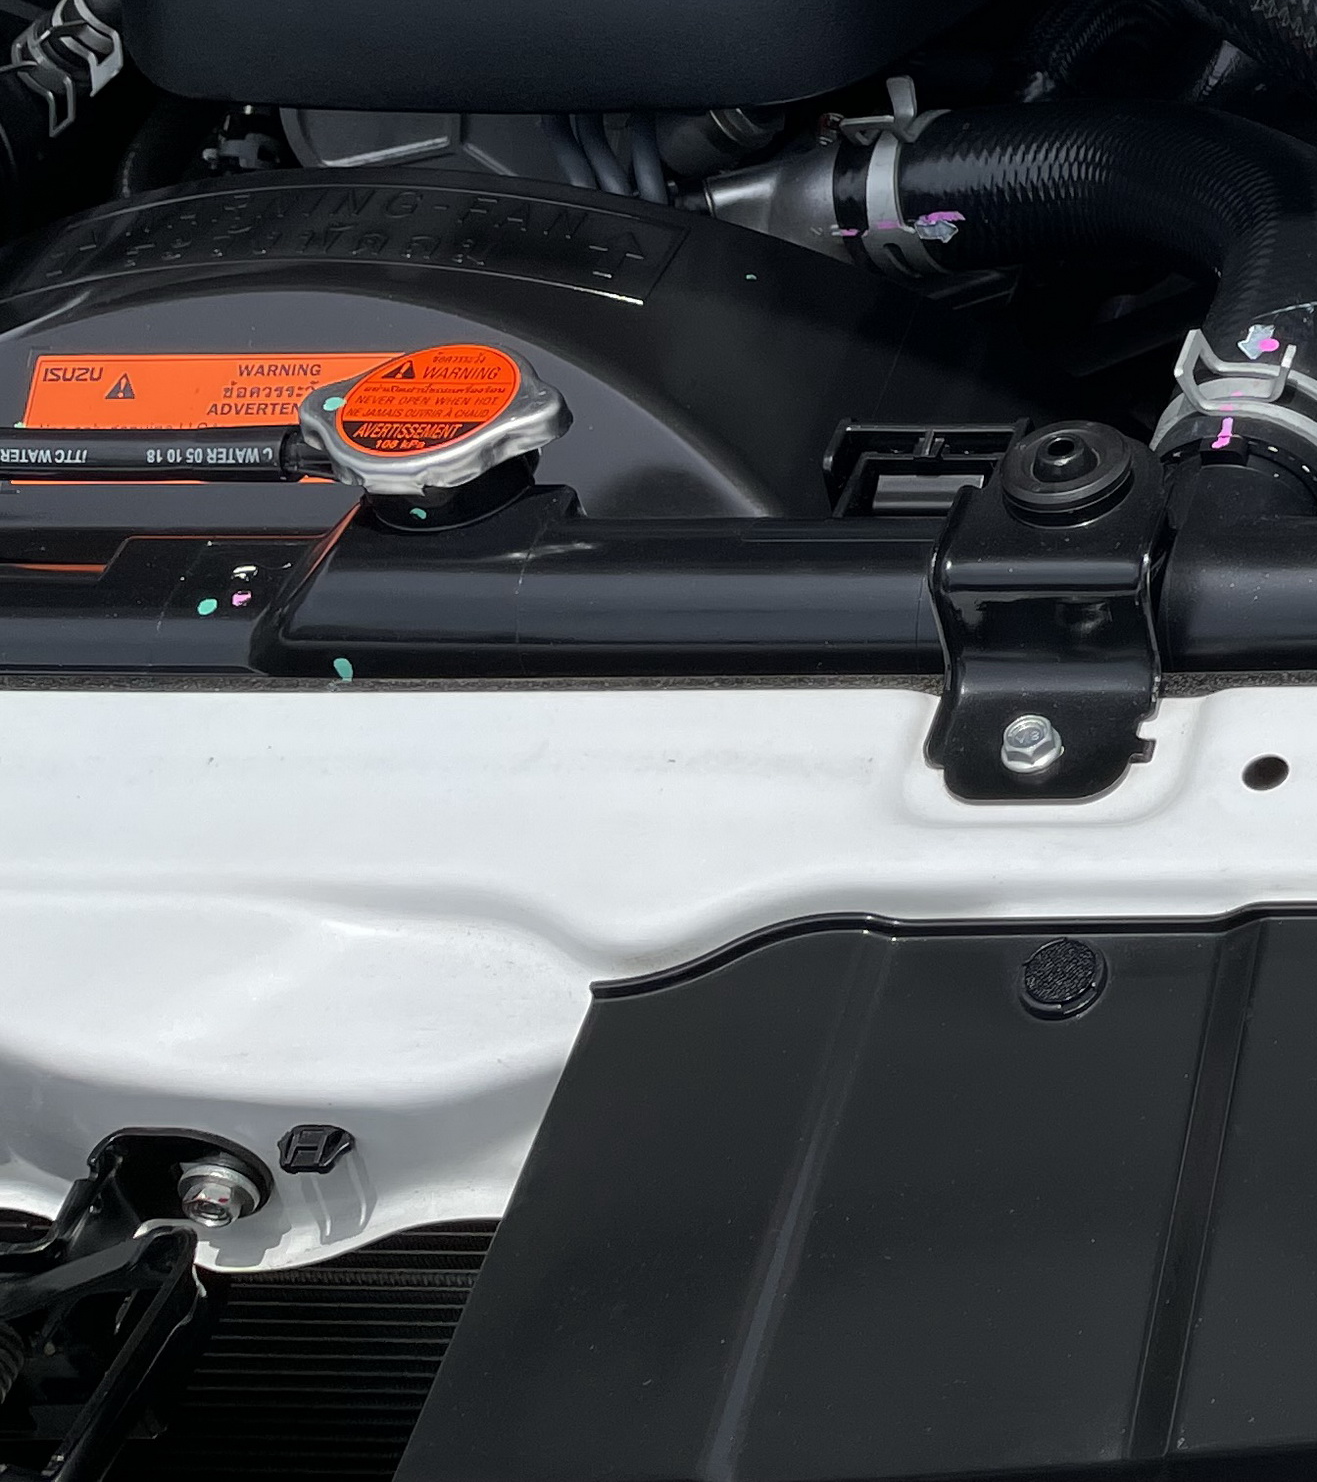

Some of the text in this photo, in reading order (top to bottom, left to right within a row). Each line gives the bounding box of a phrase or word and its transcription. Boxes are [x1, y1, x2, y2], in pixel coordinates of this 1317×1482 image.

[42, 367, 104, 383] ISUZU
[238, 363, 322, 377] WARNING
[422, 366, 502, 380] WARNING
[355, 395, 499, 406] NEVER OPEN WHEN HOT
[207, 402, 300, 416] ADVERTEN
[362, 408, 402, 417] JAMAIS
[454, 408, 490, 418] CHAUD
[352, 422, 463, 439] AVERTISSEMENT
[0, 448, 52, 464] WATER
[146, 449, 162, 463] 18
[166, 449, 182, 463] 10
[186, 448, 203, 463] 05
[206, 448, 260, 464] WATER
